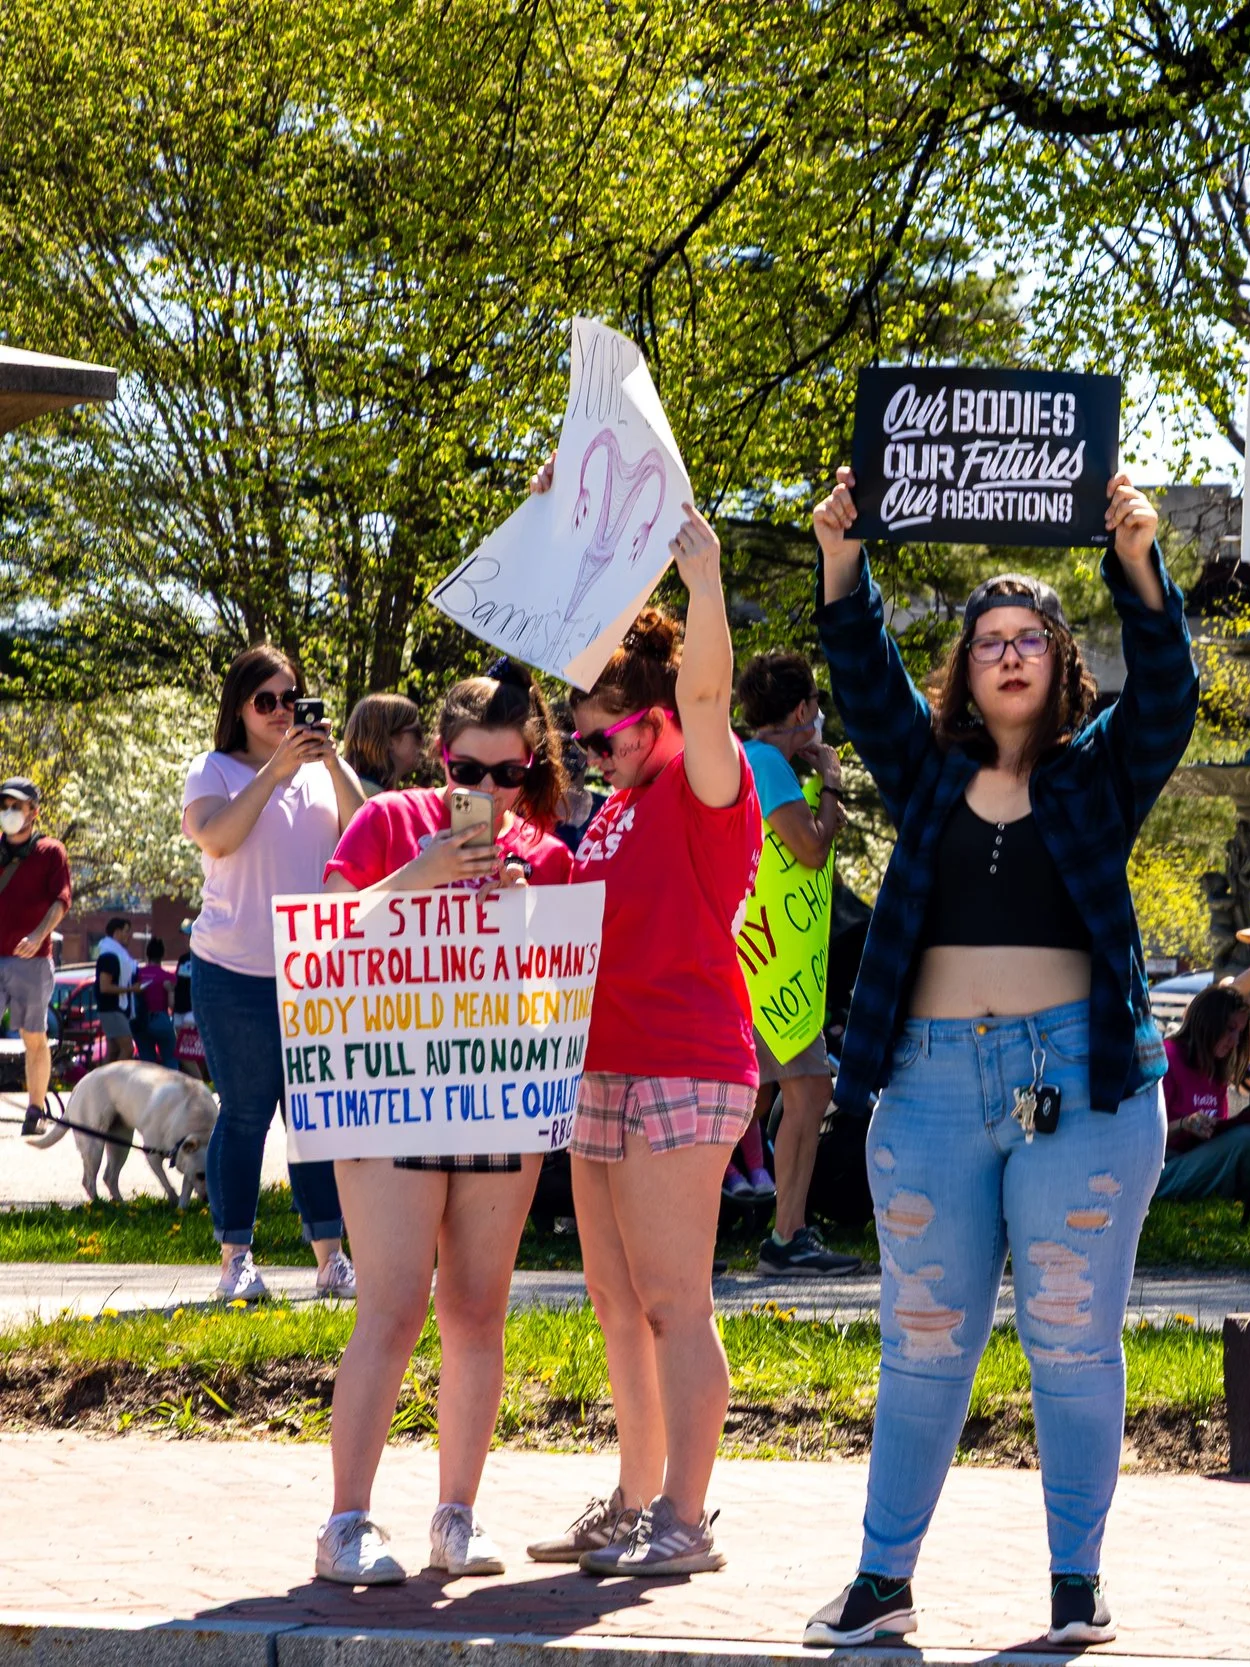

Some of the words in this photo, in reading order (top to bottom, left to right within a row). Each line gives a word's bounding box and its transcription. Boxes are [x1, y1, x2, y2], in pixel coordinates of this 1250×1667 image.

[883, 383, 948, 442] Our
[952, 388, 1076, 437] BODIES
[883, 442, 955, 481] OUR
[957, 437, 1086, 491] Futures
[880, 477, 937, 531] Our
[941, 488, 1073, 524] ABORTIONS
[275, 900, 365, 942] THE
[388, 894, 501, 937] STATE
[283, 945, 486, 990] CONTROLLING
[492, 945, 511, 981] A
[515, 941, 598, 980] WOMAN'S
[281, 995, 357, 1038] BODY
[362, 992, 444, 1033] WOULD
[453, 991, 510, 1028] MEAN
[760, 968, 812, 1034] NOT
[286, 1044, 335, 1085] HER
[344, 1040, 416, 1081] FULL
[425, 1036, 562, 1077] AUTONOMY
[290, 1086, 433, 1132] ULTIMATELY
[445, 1083, 496, 1122] FULL
[503, 1070, 584, 1123] EQUALIT
